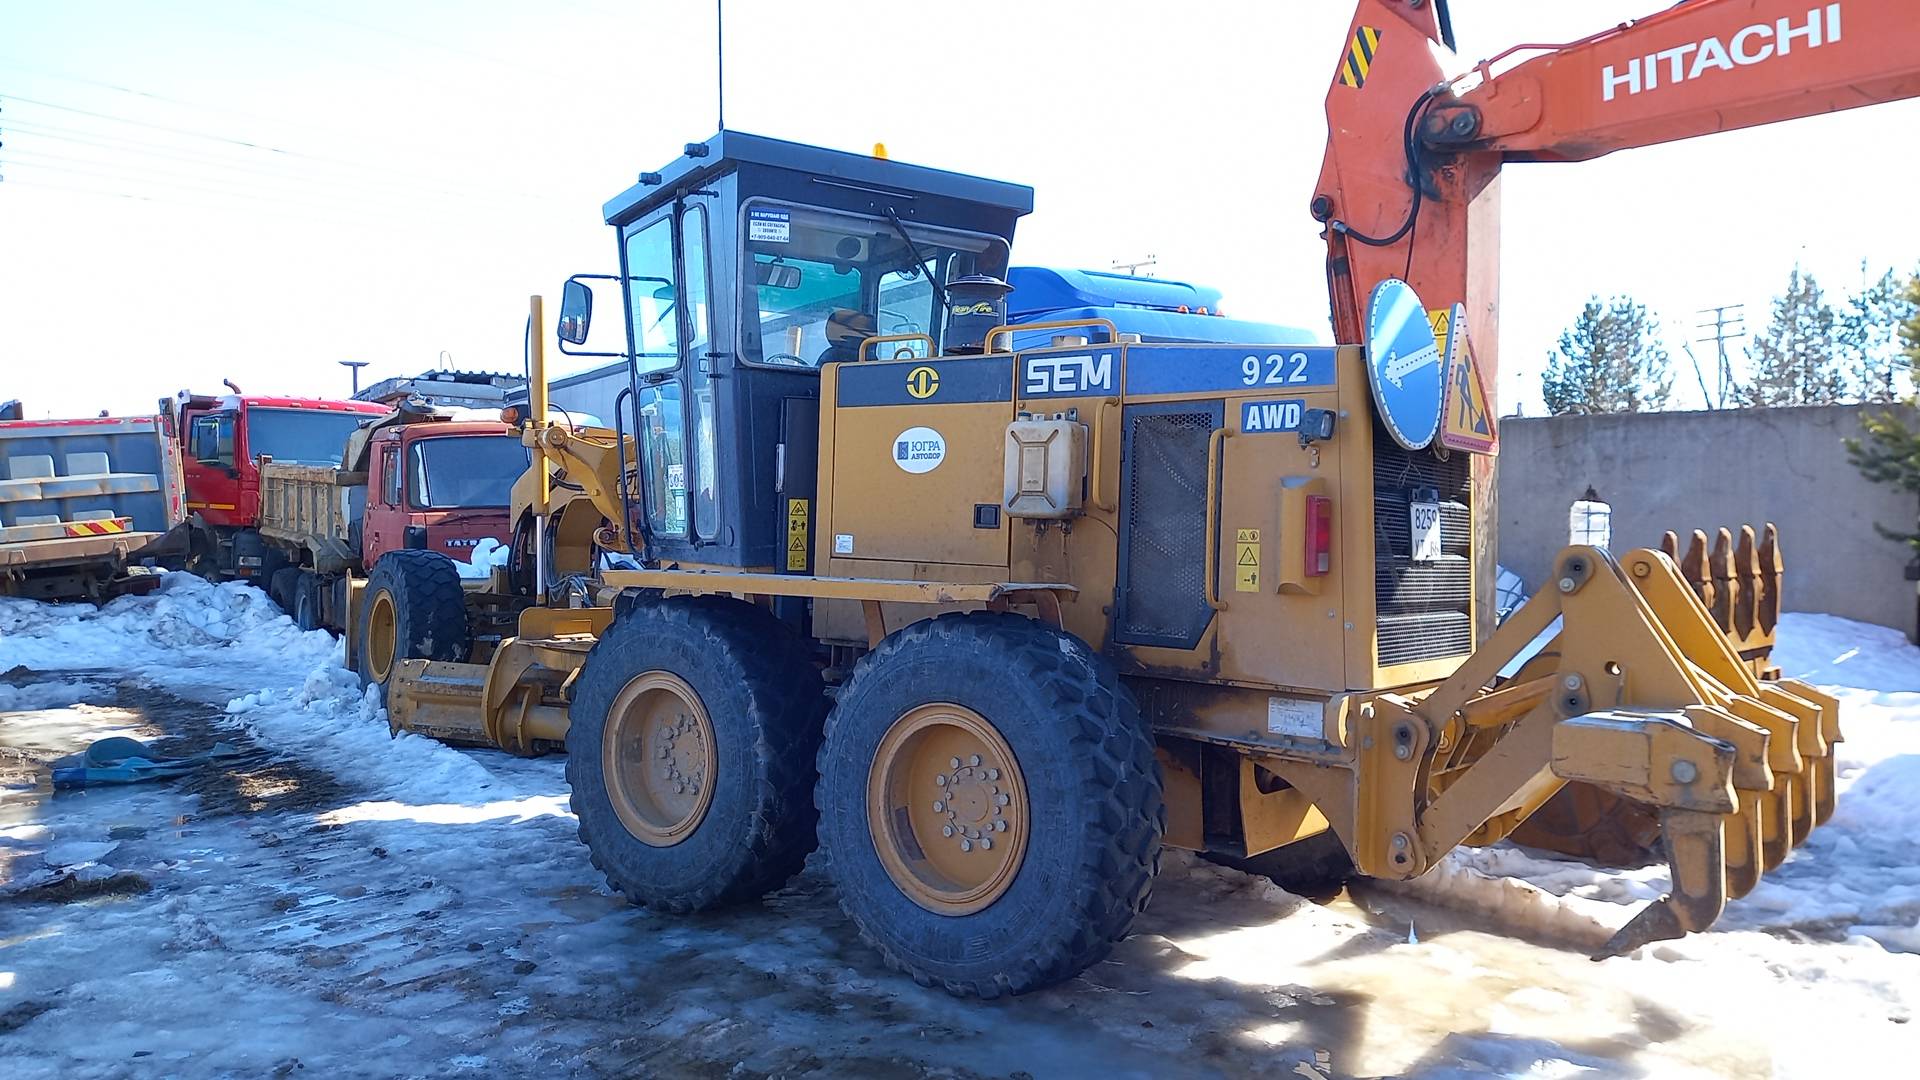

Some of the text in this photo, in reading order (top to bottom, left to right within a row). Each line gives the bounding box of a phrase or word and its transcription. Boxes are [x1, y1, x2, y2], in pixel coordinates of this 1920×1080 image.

[1602, 3, 1842, 102] HITACHI
[1026, 354, 1112, 393] SEM
[1242, 352, 1308, 385] 922
[1246, 403, 1301, 431] AWD
[911, 440, 941, 451] ЮГРА
[911, 452, 941, 460] АВТОДОР
[446, 539, 481, 547] TATR
